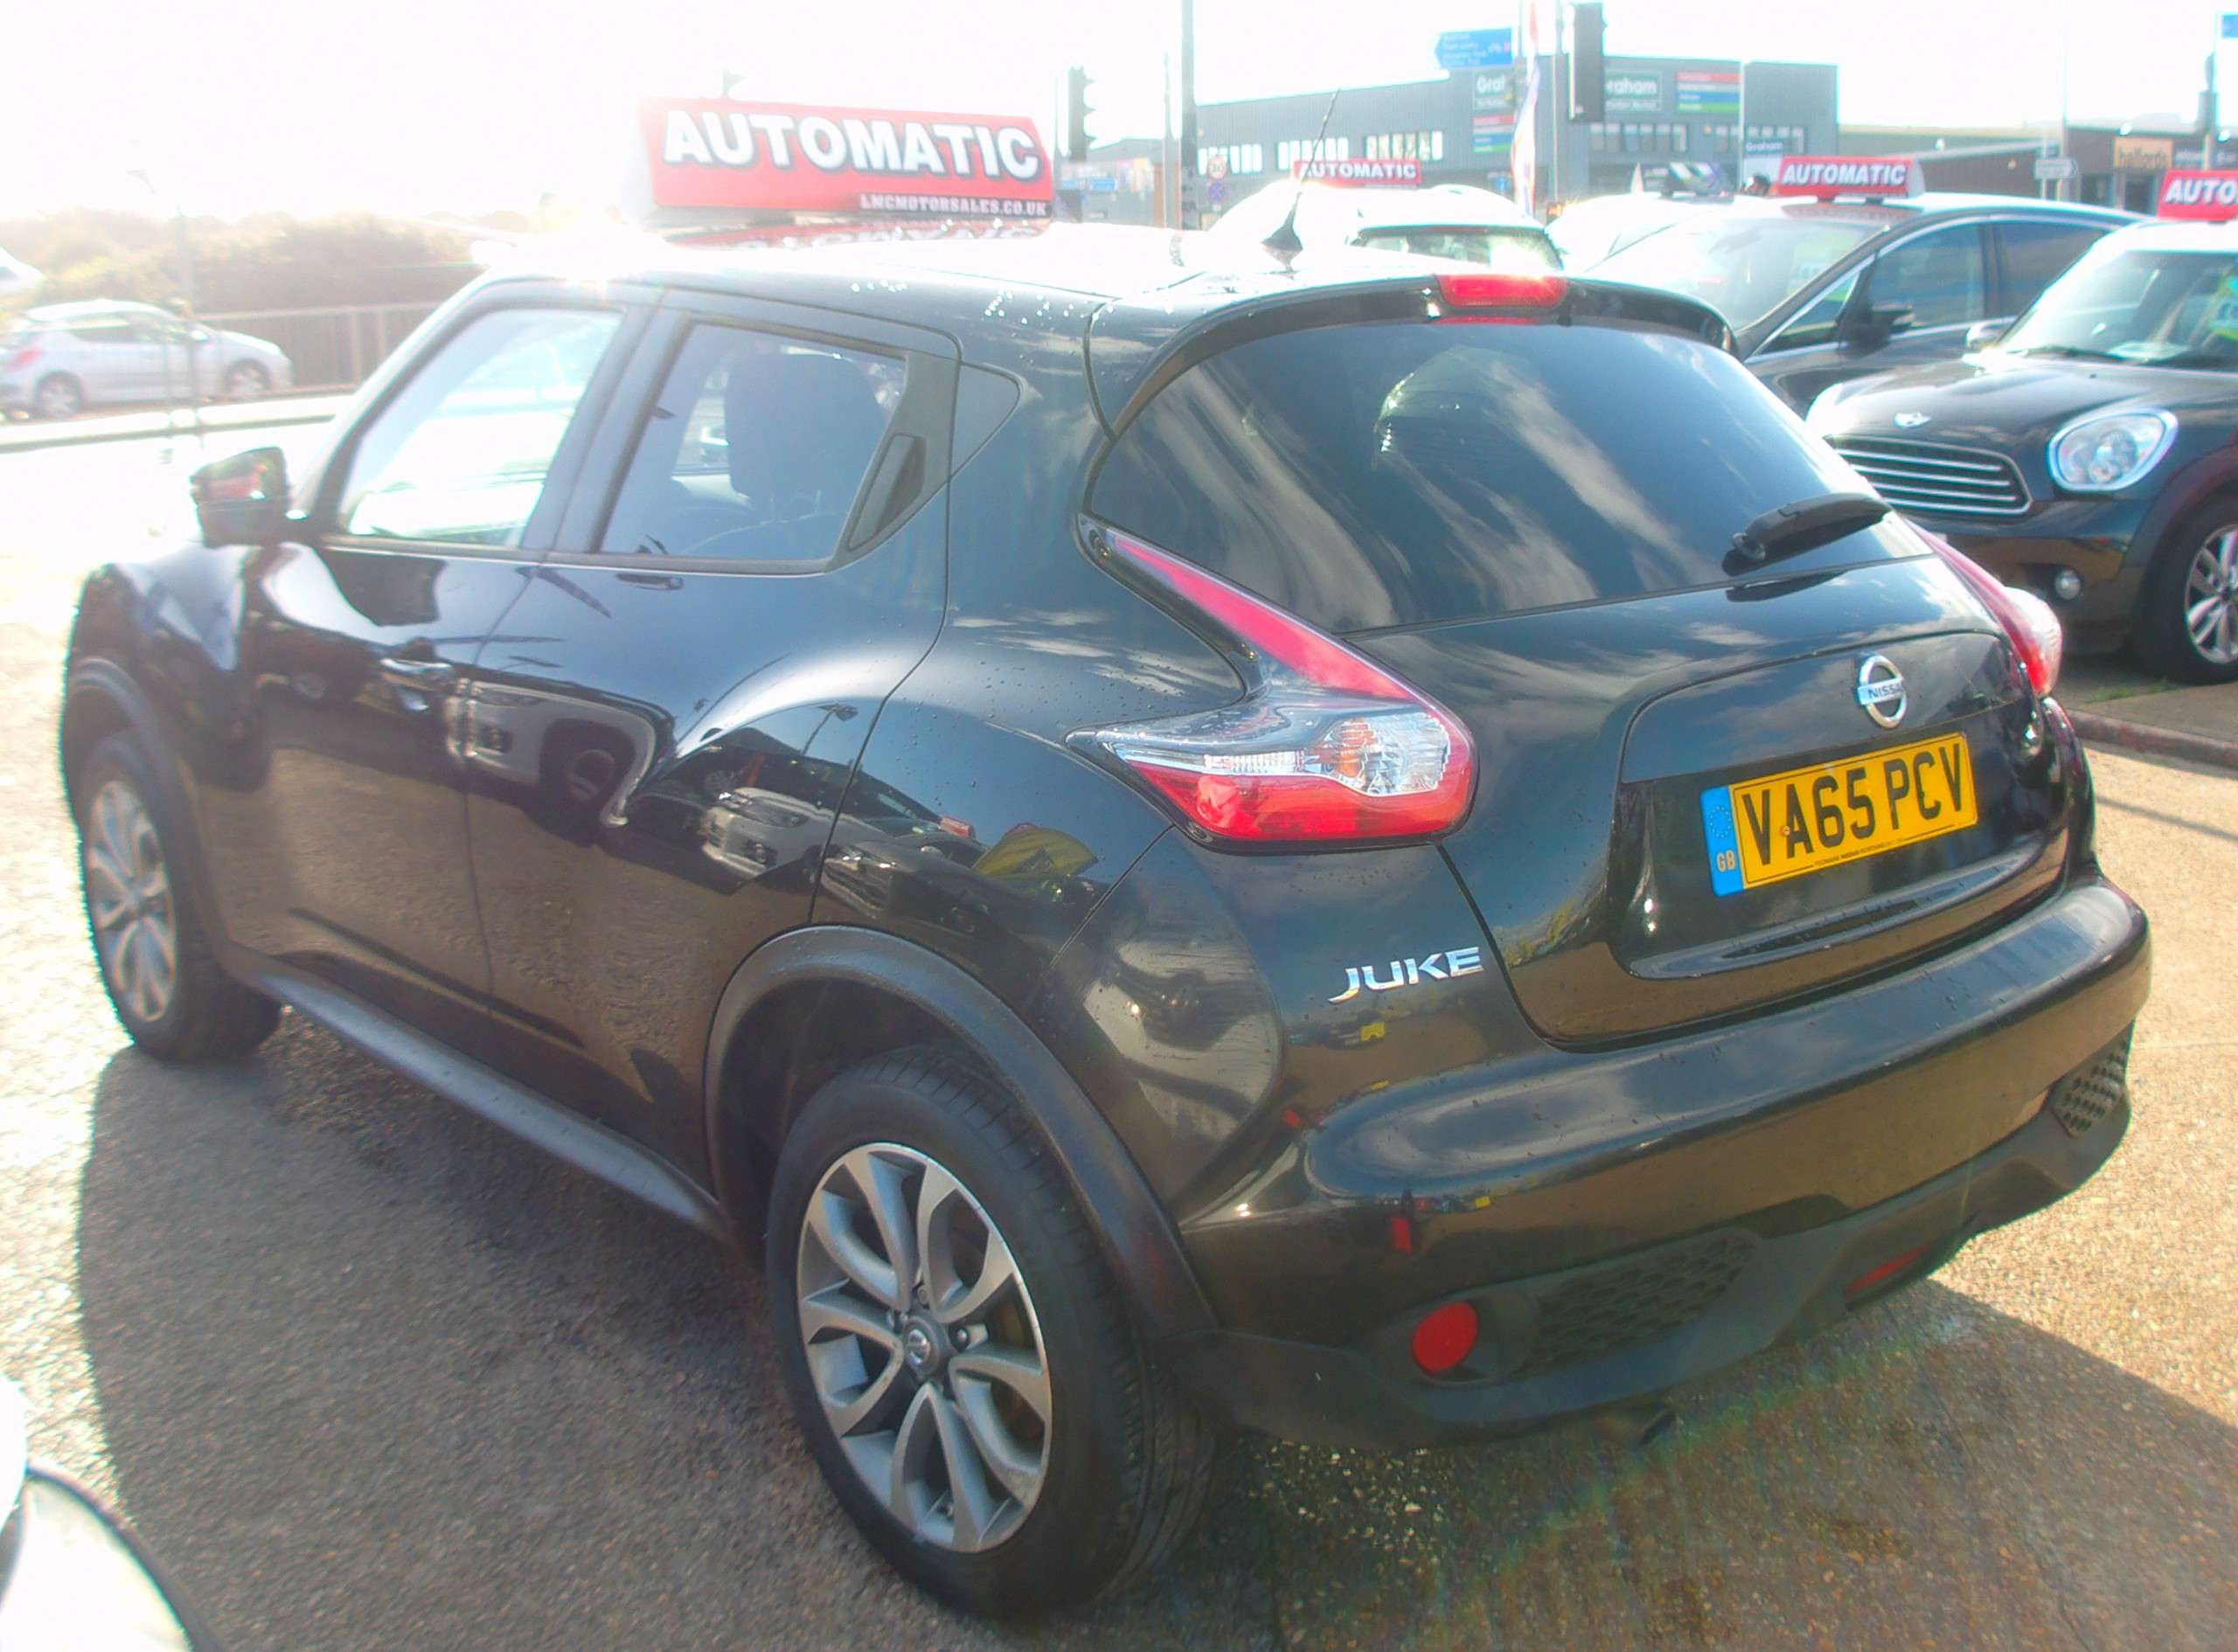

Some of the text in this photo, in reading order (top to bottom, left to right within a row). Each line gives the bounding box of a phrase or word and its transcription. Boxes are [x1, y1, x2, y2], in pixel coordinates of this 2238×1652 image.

[663, 110, 1039, 179] AUTOMATIC
[1300, 162, 1416, 179] AUTOMATIC
[1783, 163, 1907, 186] AUTOMATIC
[860, 193, 1046, 216] LMCMOTORSALES.CO.UK
[1743, 743, 1963, 866] VA65 PCV
[1716, 849, 1736, 873] GB
[1327, 946, 1484, 1004] JUKE
